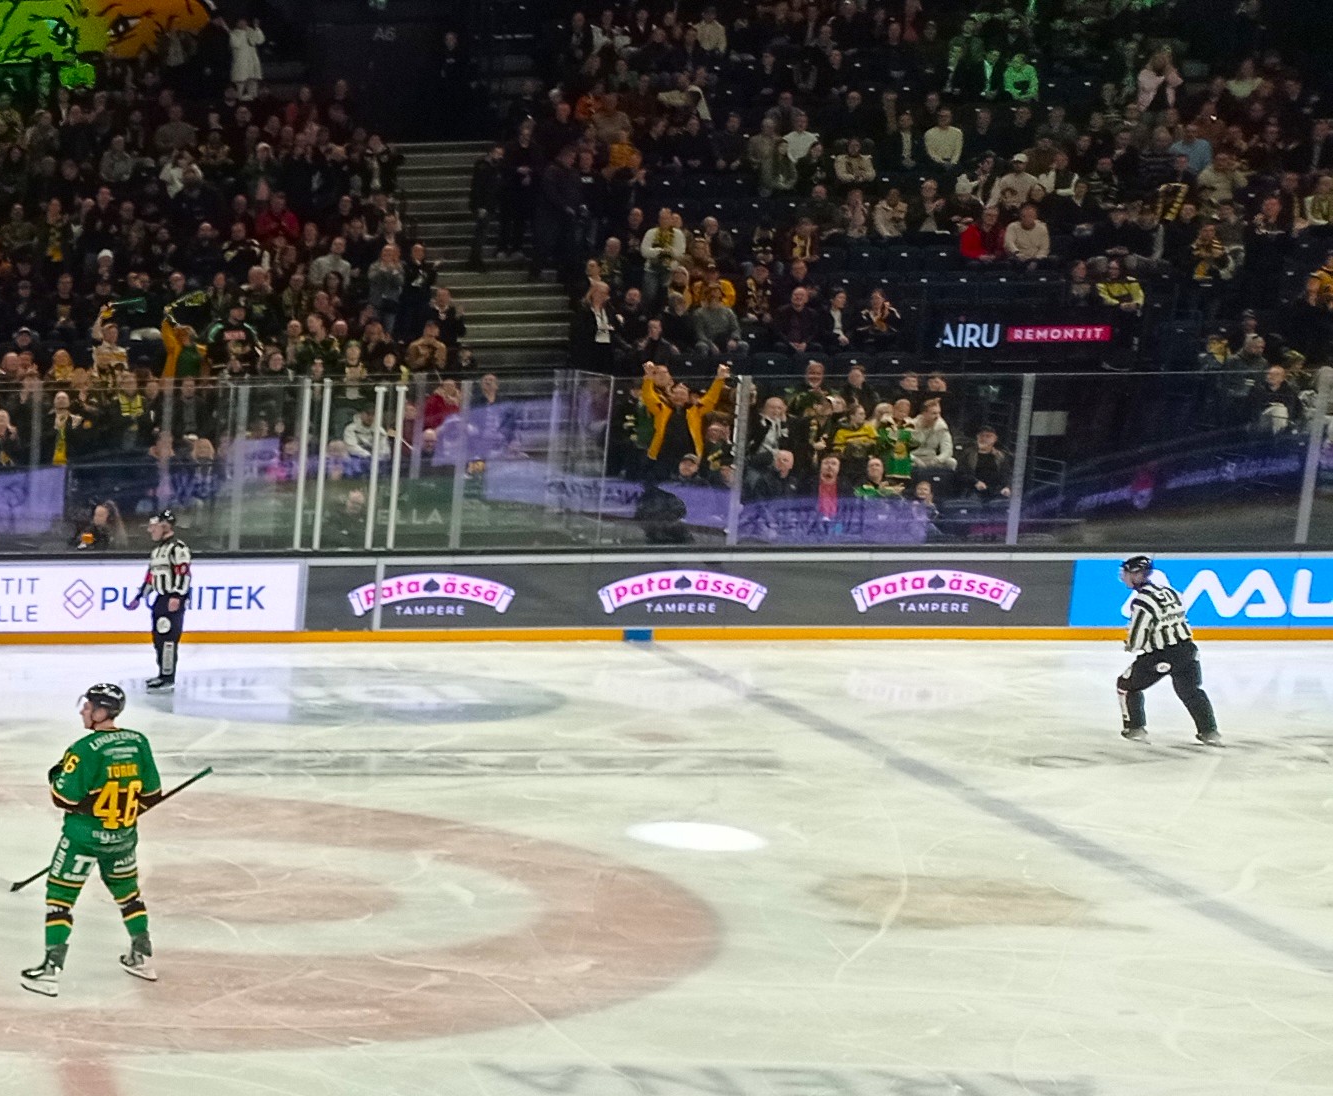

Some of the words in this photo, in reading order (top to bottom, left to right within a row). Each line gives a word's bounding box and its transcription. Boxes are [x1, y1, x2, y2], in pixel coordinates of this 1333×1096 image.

[1013, 327, 1104, 340] REMONTIT
[444, 577, 498, 602] ässä
[615, 576, 671, 602] pata
[695, 574, 750, 601] ässä
[867, 576, 924, 602] pata
[949, 573, 1004, 600] ässä
[395, 604, 464, 616] TAMPERE
[646, 602, 716, 614] TAMPERE
[899, 603, 969, 613] TAMPERE
[93, 780, 143, 830] 46
